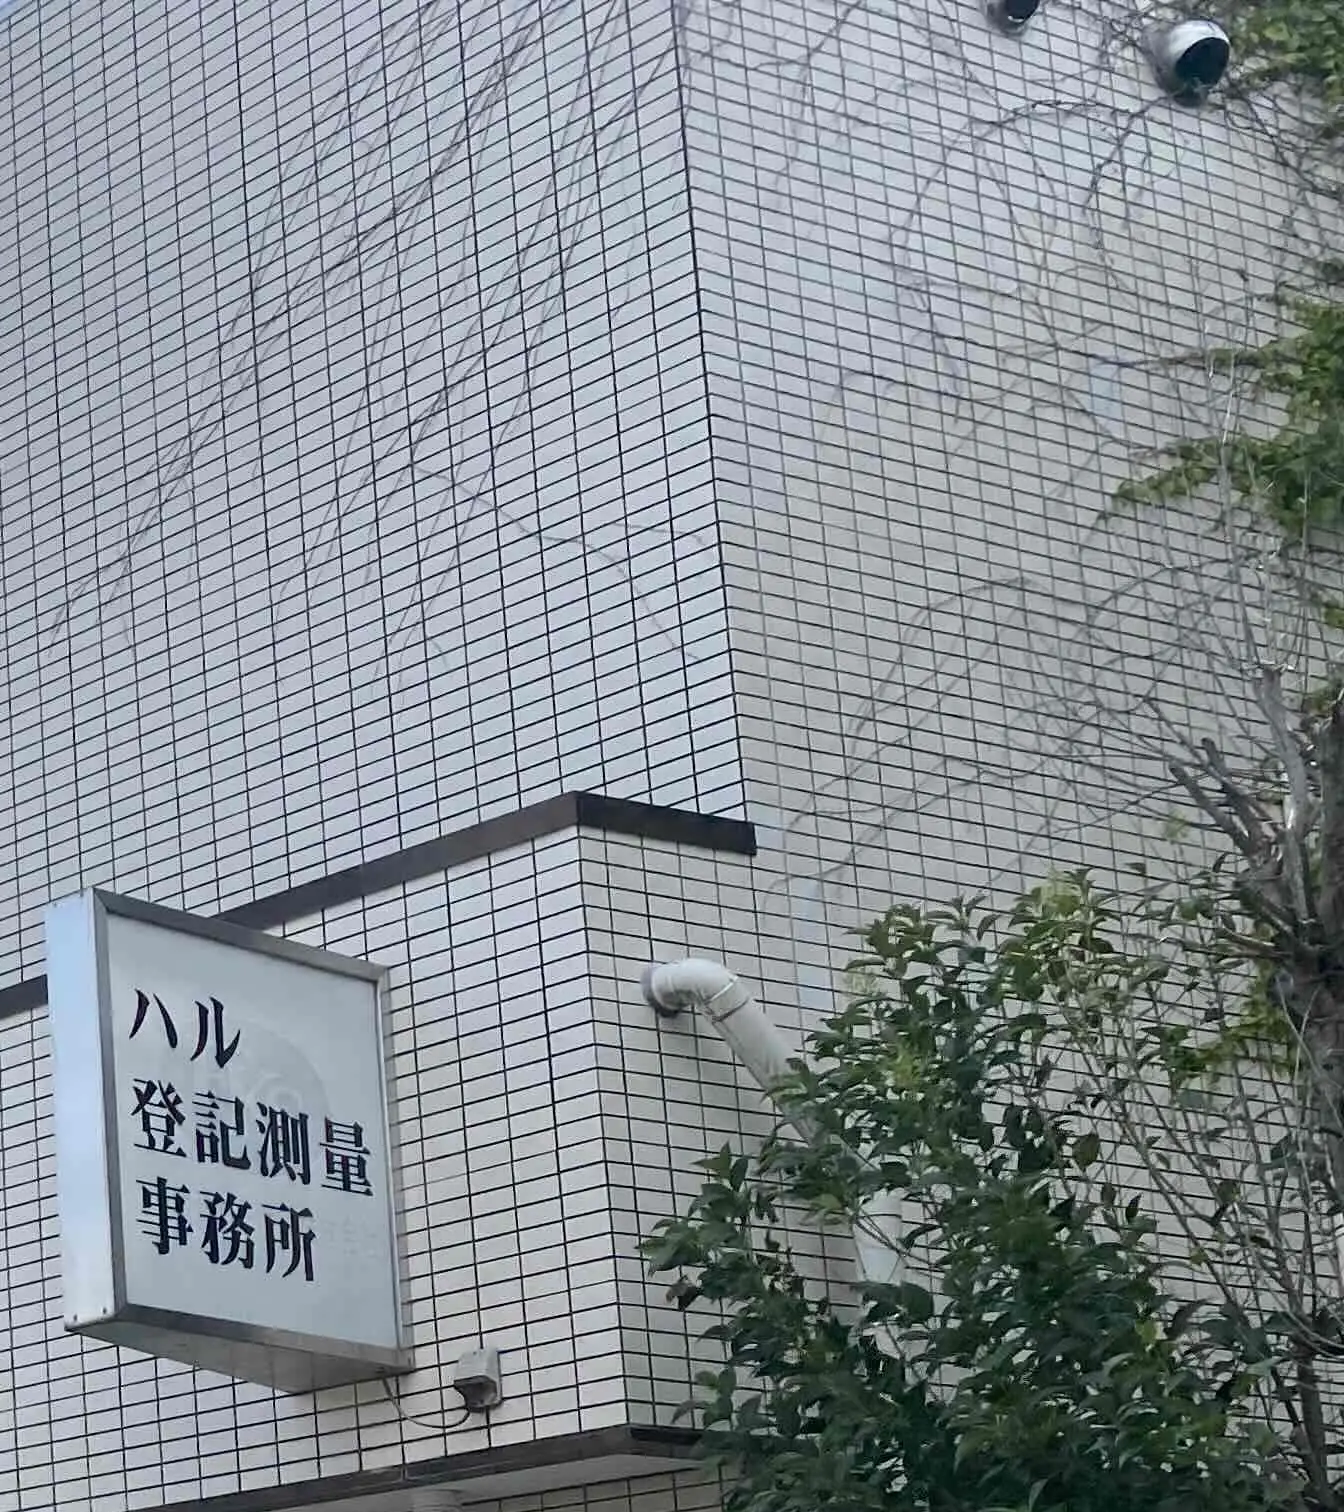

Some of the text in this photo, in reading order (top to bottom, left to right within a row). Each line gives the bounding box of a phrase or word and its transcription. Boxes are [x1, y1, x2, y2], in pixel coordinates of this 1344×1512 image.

[128, 989, 241, 1068] ハル
[130, 1078, 373, 1196] 登記測量
[135, 1176, 316, 1281] 事務所
